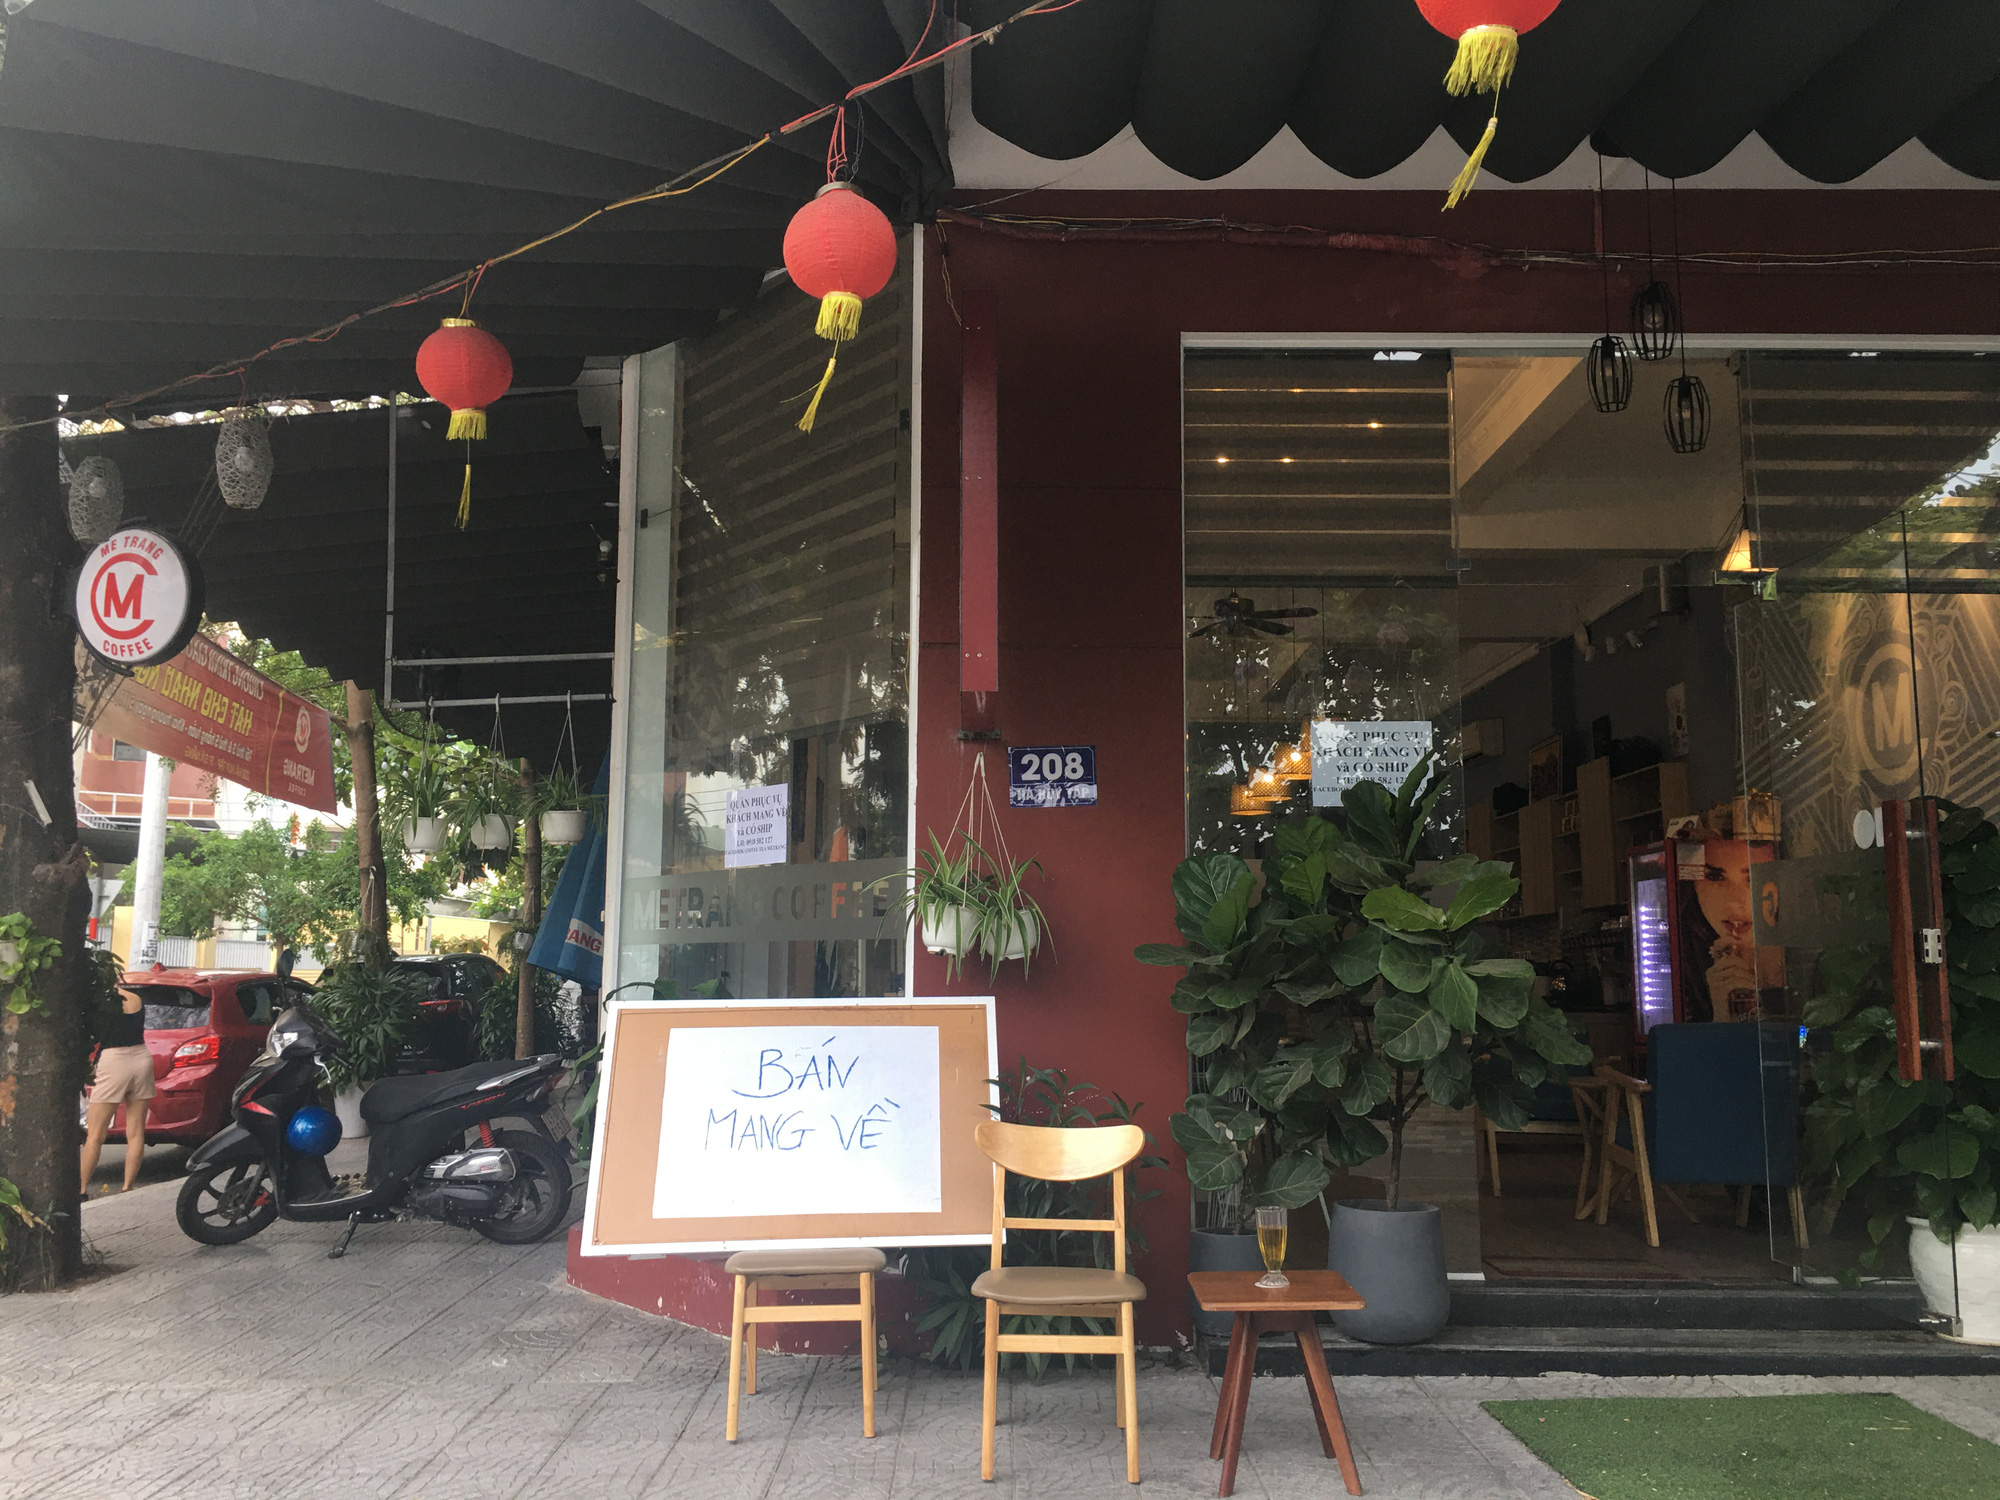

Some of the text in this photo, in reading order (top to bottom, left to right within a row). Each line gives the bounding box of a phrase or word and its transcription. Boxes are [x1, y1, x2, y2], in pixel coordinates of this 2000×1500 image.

[100, 536, 164, 560] ME TRANG
[103, 638, 154, 658] COFFEE
[1021, 752, 1084, 781] 208
[1336, 760, 1409, 773] và CÓ SHIP
[753, 809, 774, 820] MANG
[745, 822, 757, 836] CÓ
[757, 822, 773, 834] SHIP
[771, 880, 890, 921] COFFEE
[731, 1035, 860, 1099] BÁN
[704, 1097, 901, 1152] MANG VỀ
